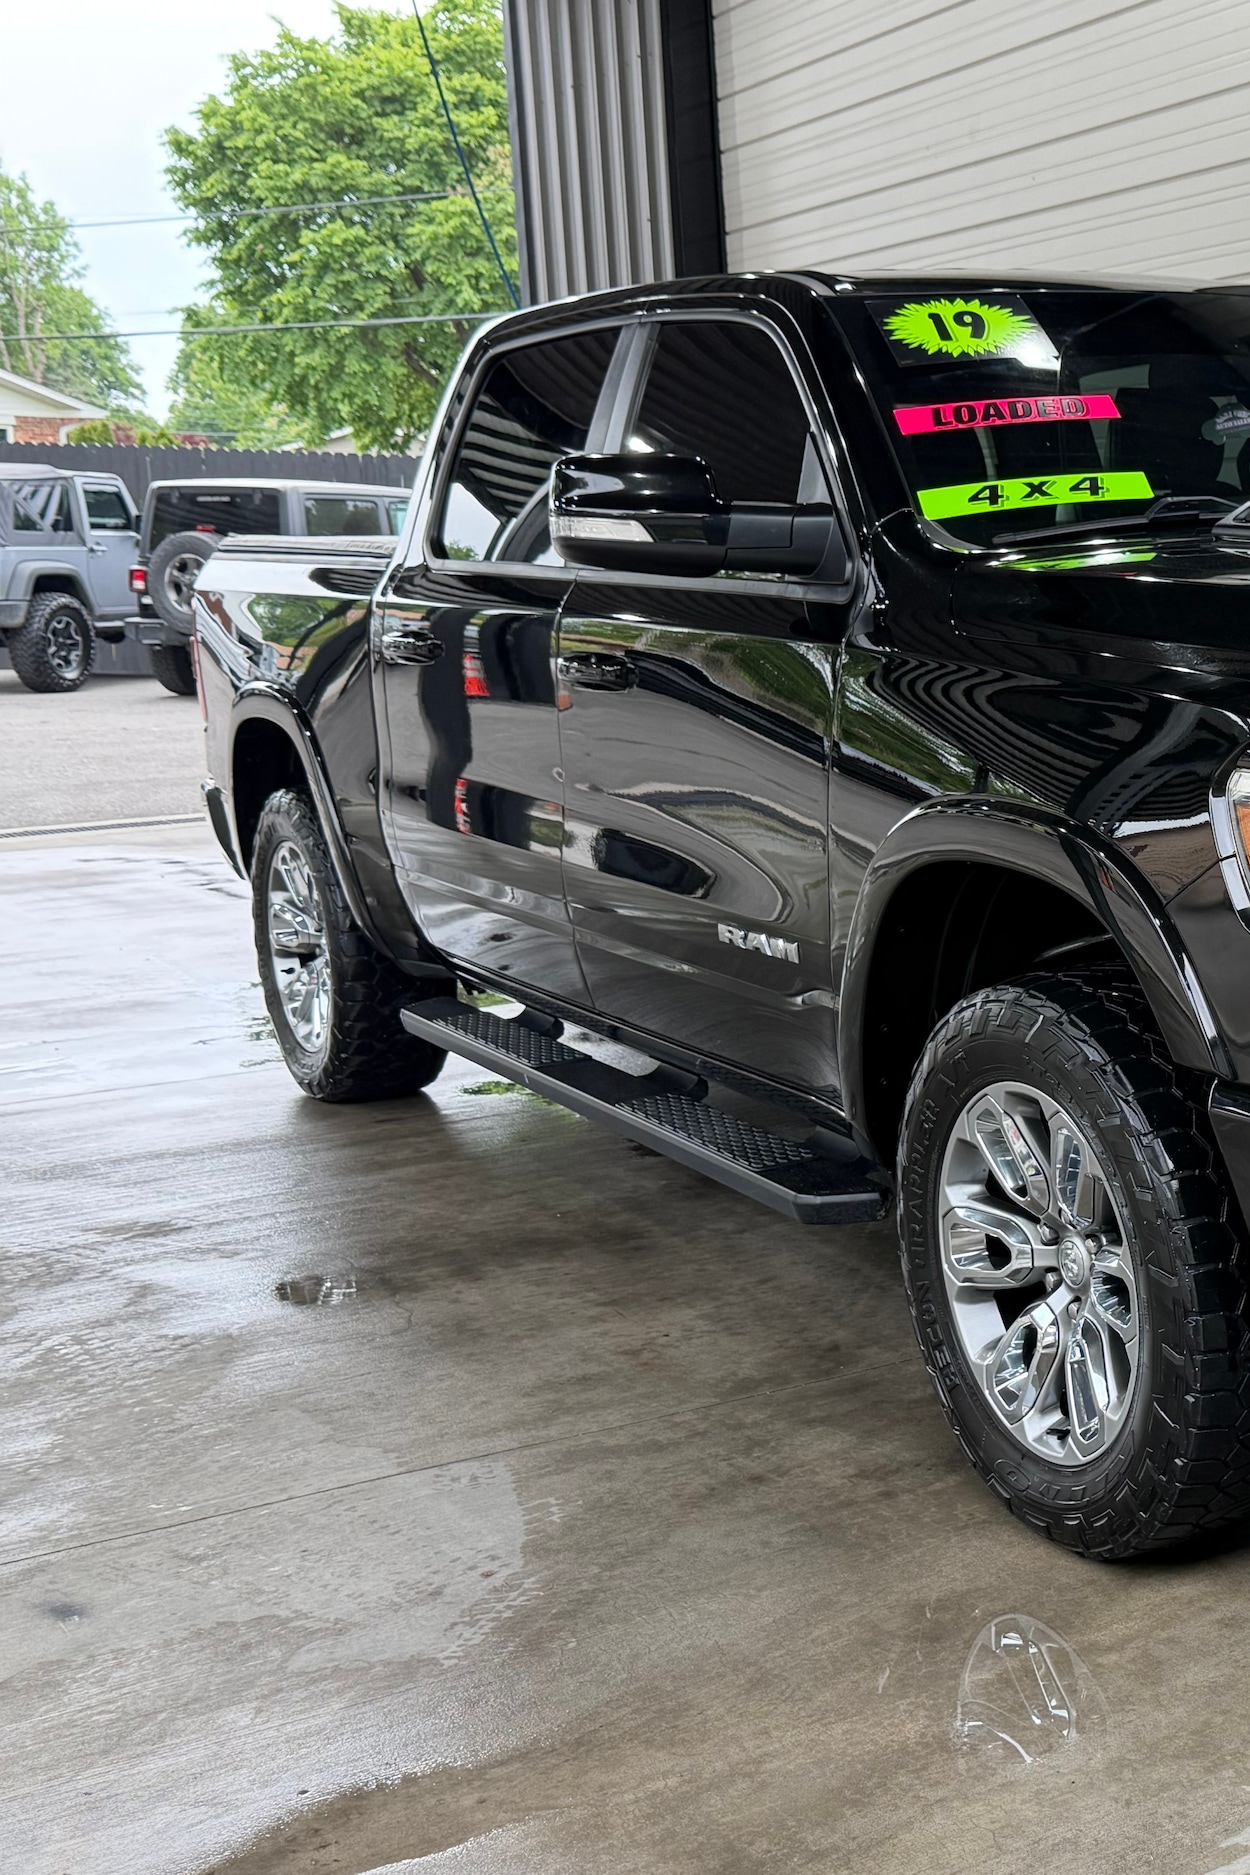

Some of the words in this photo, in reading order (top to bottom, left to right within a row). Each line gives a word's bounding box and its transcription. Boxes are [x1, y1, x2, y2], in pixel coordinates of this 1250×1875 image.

[928, 310, 987, 342] 19
[931, 398, 1087, 429] LOADED
[717, 922, 800, 965] RAM
